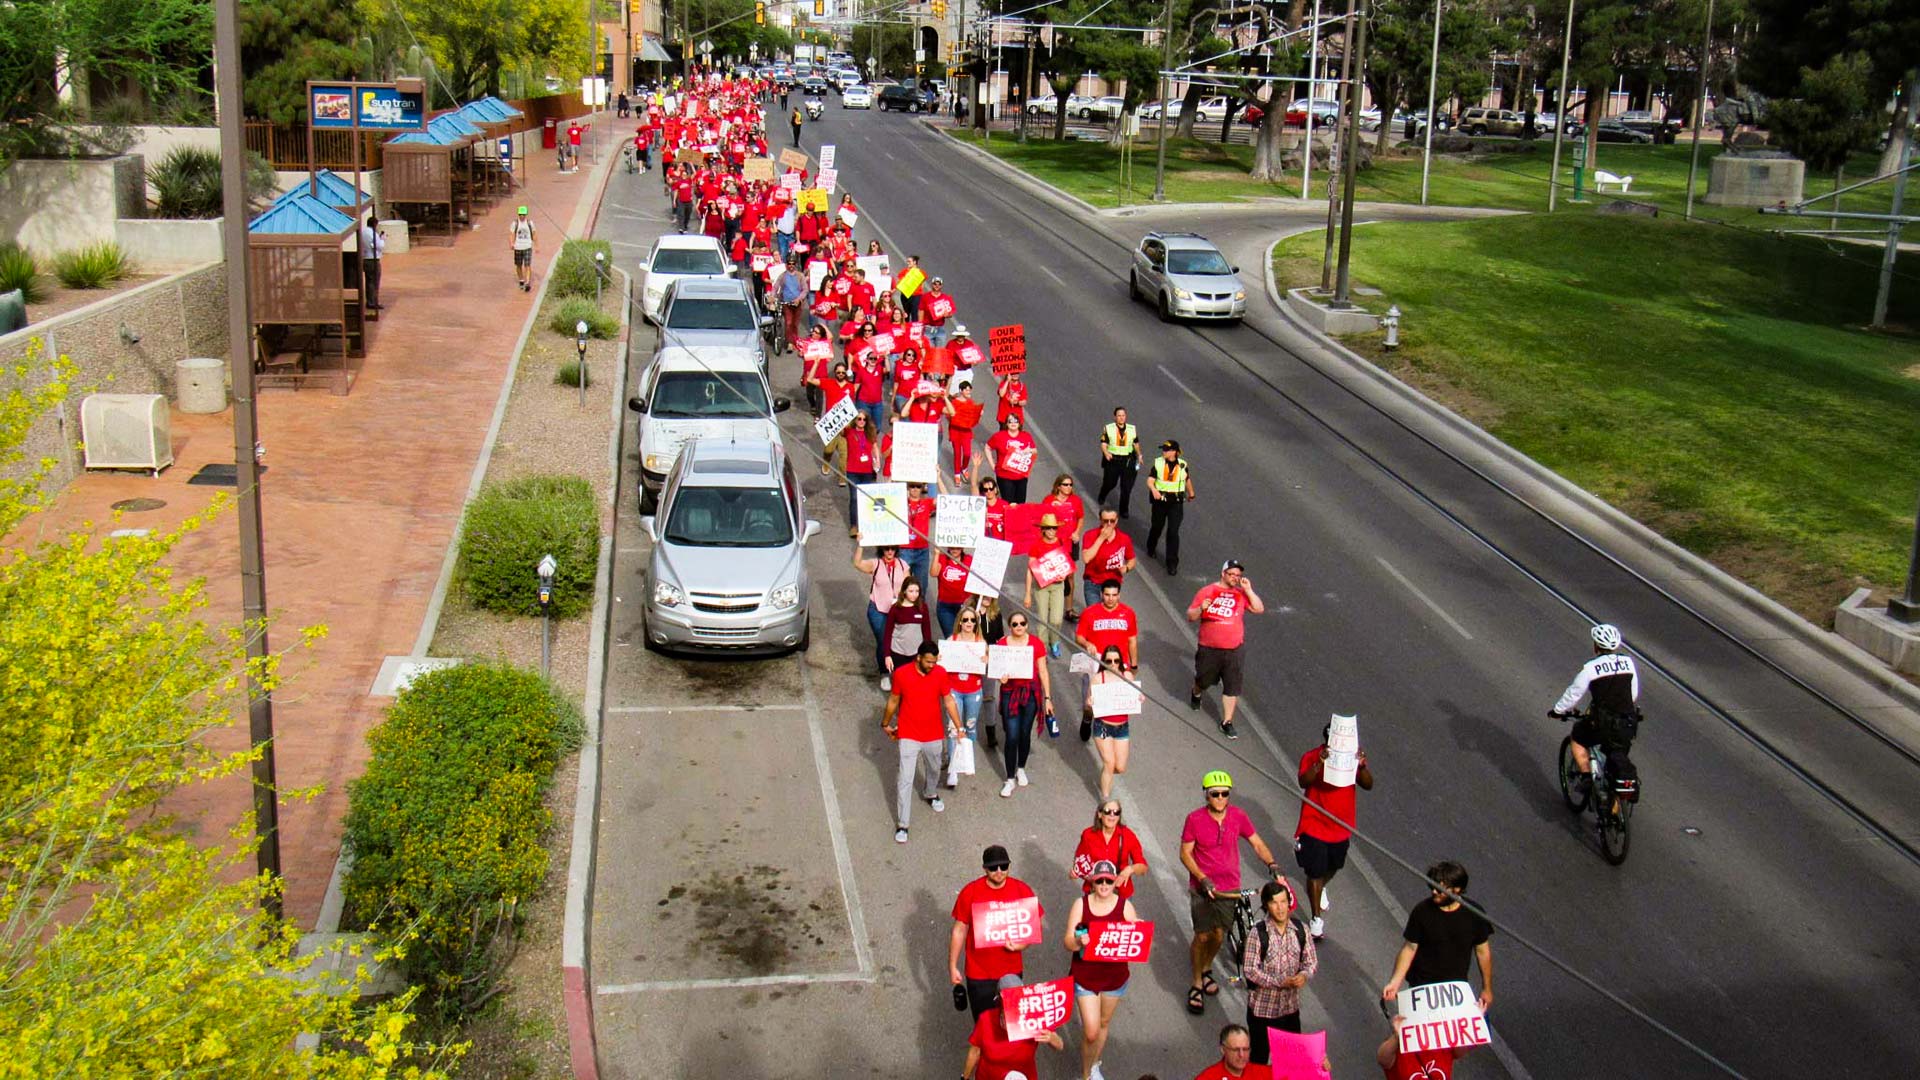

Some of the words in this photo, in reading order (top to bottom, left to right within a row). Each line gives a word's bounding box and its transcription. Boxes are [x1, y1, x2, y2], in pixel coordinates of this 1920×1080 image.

[370, 99, 391, 107] sun
[392, 98, 416, 107] tran
[996, 327, 1015, 336] OUR
[999, 345, 1014, 353] ARE
[819, 416, 829, 428] WE
[831, 400, 849, 415] WILL
[824, 408, 848, 433] NOT
[826, 411, 854, 441] COMPLY
[938, 512, 966, 523] better
[936, 533, 978, 546] MONEY
[1207, 605, 1233, 617] forED
[1594, 660, 1630, 675] POLICE
[985, 909, 1031, 926] #RED
[984, 923, 1033, 942] forED
[1107, 922, 1116, 930] We
[1116, 921, 1137, 931] Support
[1099, 931, 1144, 944] #RED
[1094, 944, 1141, 957] forED
[1022, 986, 1033, 995] We
[1034, 983, 1057, 995] Support
[1018, 990, 1067, 1014] #RED
[1410, 983, 1464, 1011] FUND
[1018, 1006, 1066, 1032] forED
[1401, 1016, 1488, 1052] FUTURE
